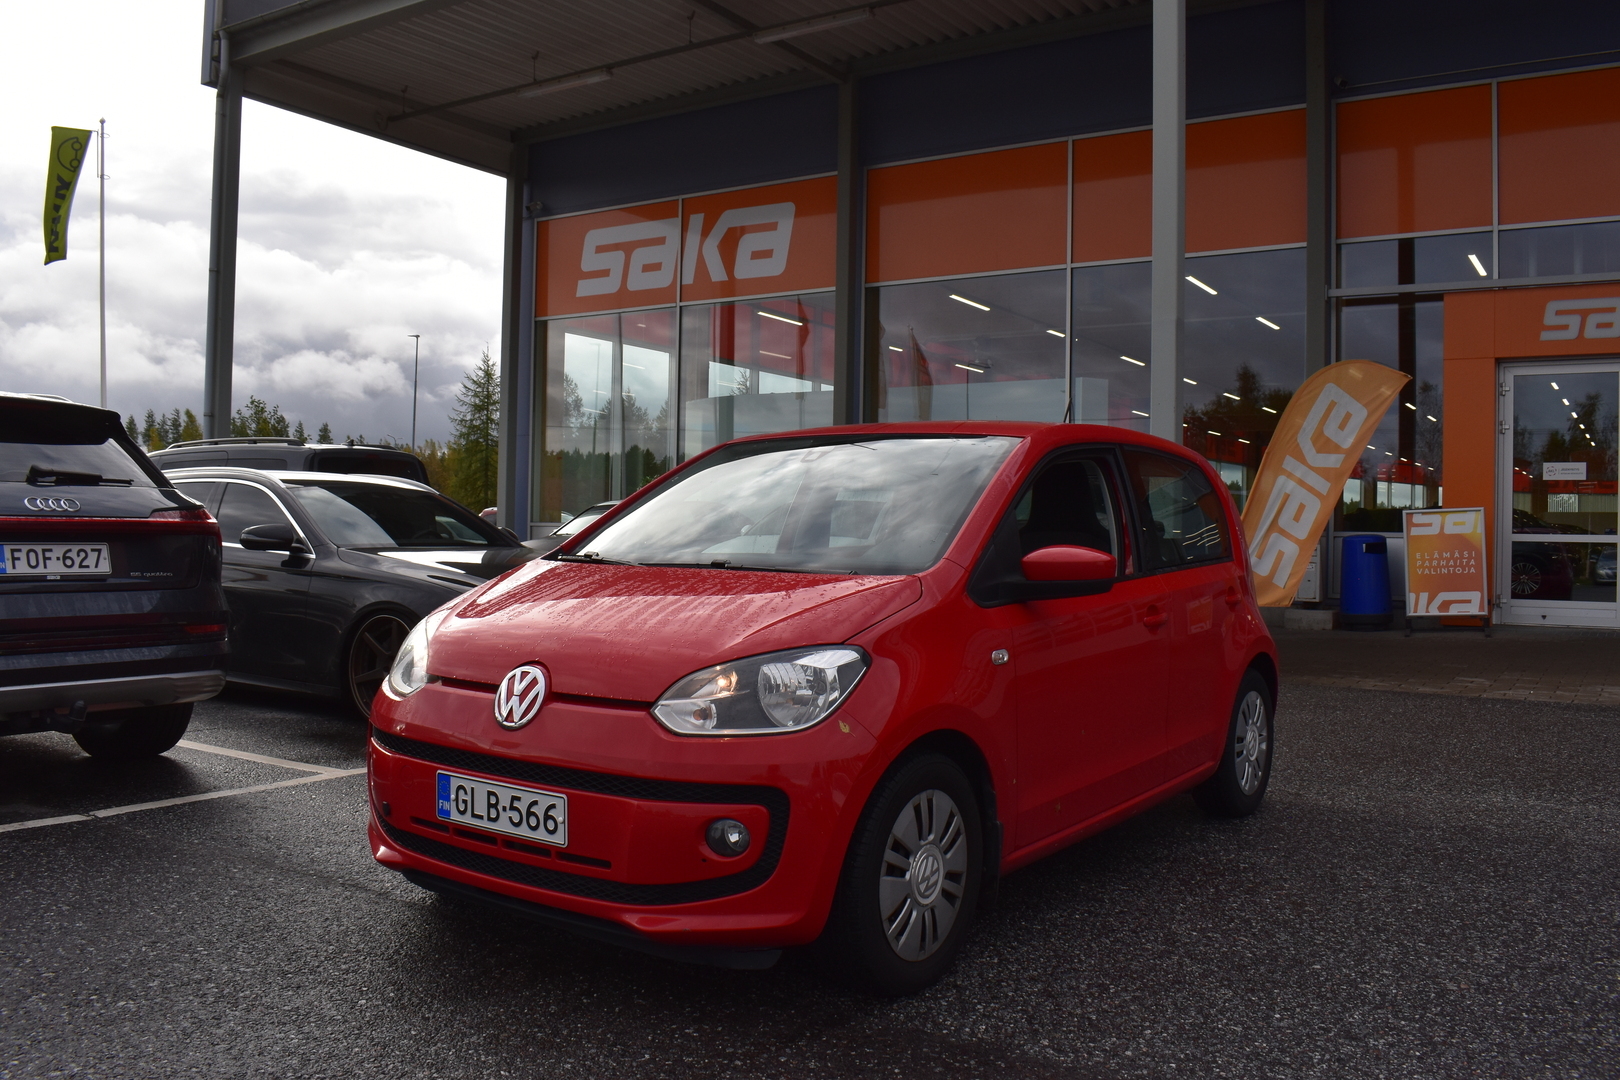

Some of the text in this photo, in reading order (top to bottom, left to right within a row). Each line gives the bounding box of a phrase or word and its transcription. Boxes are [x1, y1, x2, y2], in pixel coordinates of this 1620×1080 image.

[10, 547, 103, 570] FOF-627
[1416, 550, 1475, 559] ELÄMÄSI
[1416, 558, 1476, 567] PARHAITA
[1416, 567, 1476, 575] VALINTOJA
[438, 800, 450, 811] FIN
[454, 783, 559, 835] GLB-566
